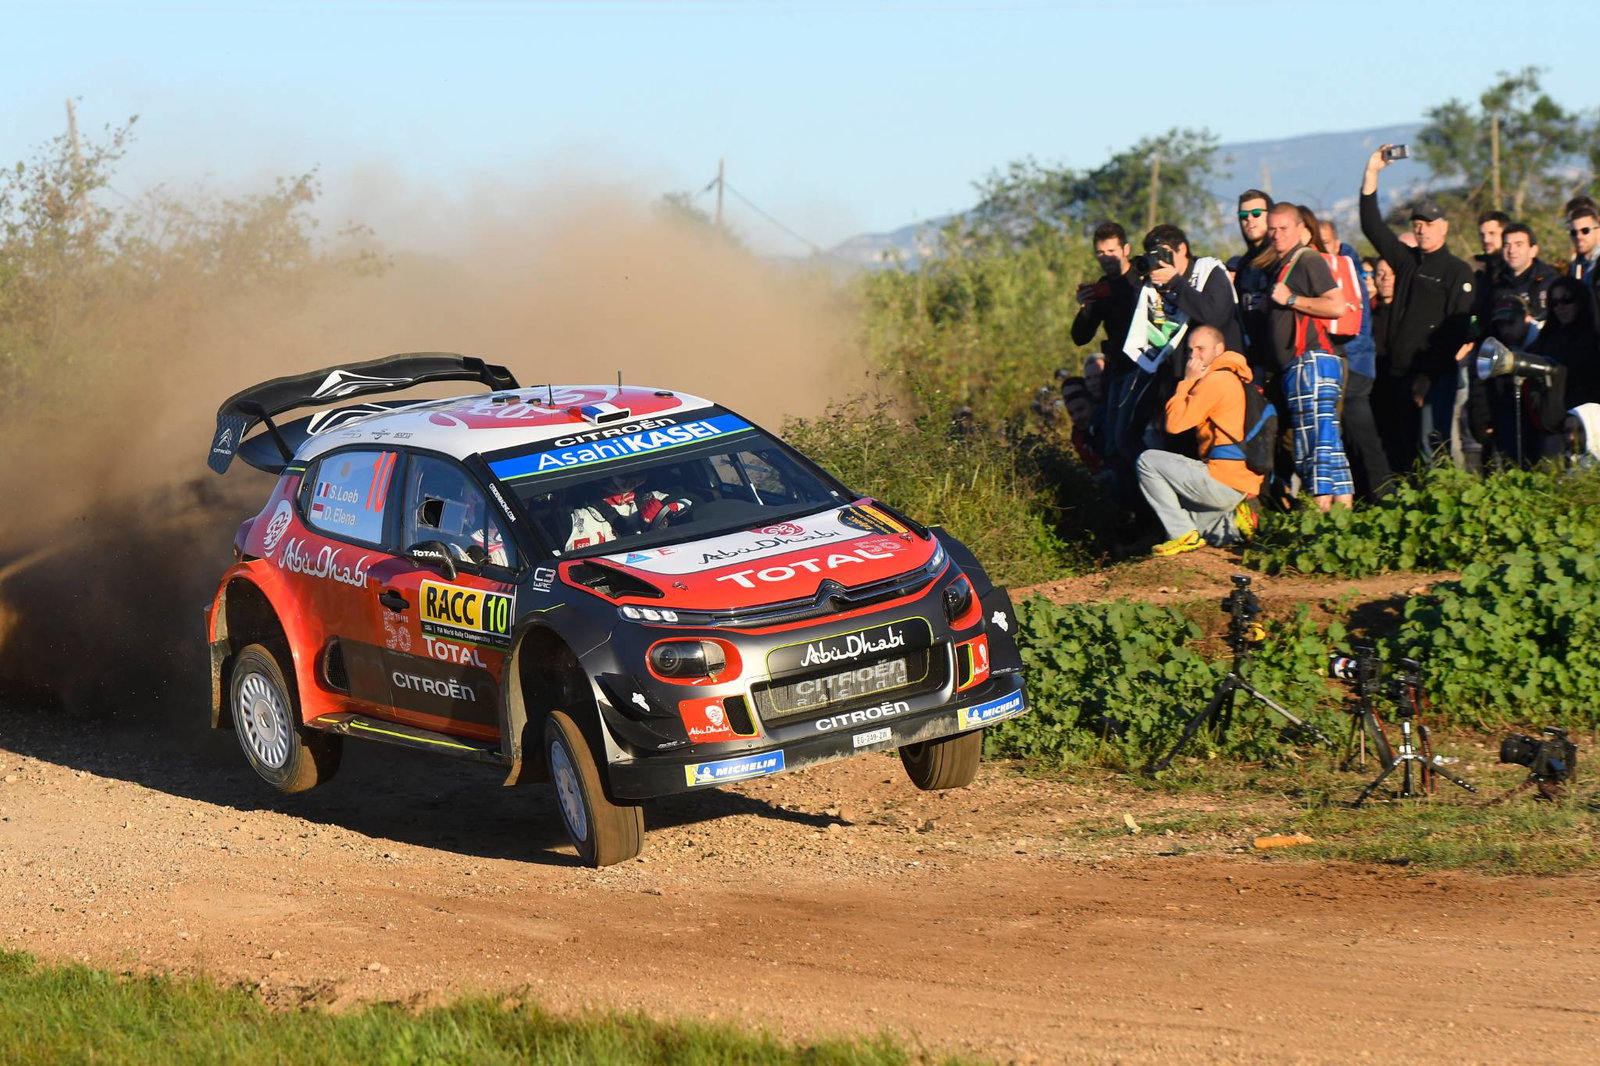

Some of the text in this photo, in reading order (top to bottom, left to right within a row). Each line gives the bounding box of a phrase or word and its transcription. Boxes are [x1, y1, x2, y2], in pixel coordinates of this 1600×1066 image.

[364, 450, 398, 513] 10
[412, 549, 443, 558] TOTAL
[716, 548, 896, 589] TOTAL
[426, 586, 477, 626] RACC
[487, 595, 508, 634] 10
[422, 635, 487, 669] TOTAL
[982, 697, 1020, 717] MICHELIN
[715, 758, 777, 776] MICHELIN
